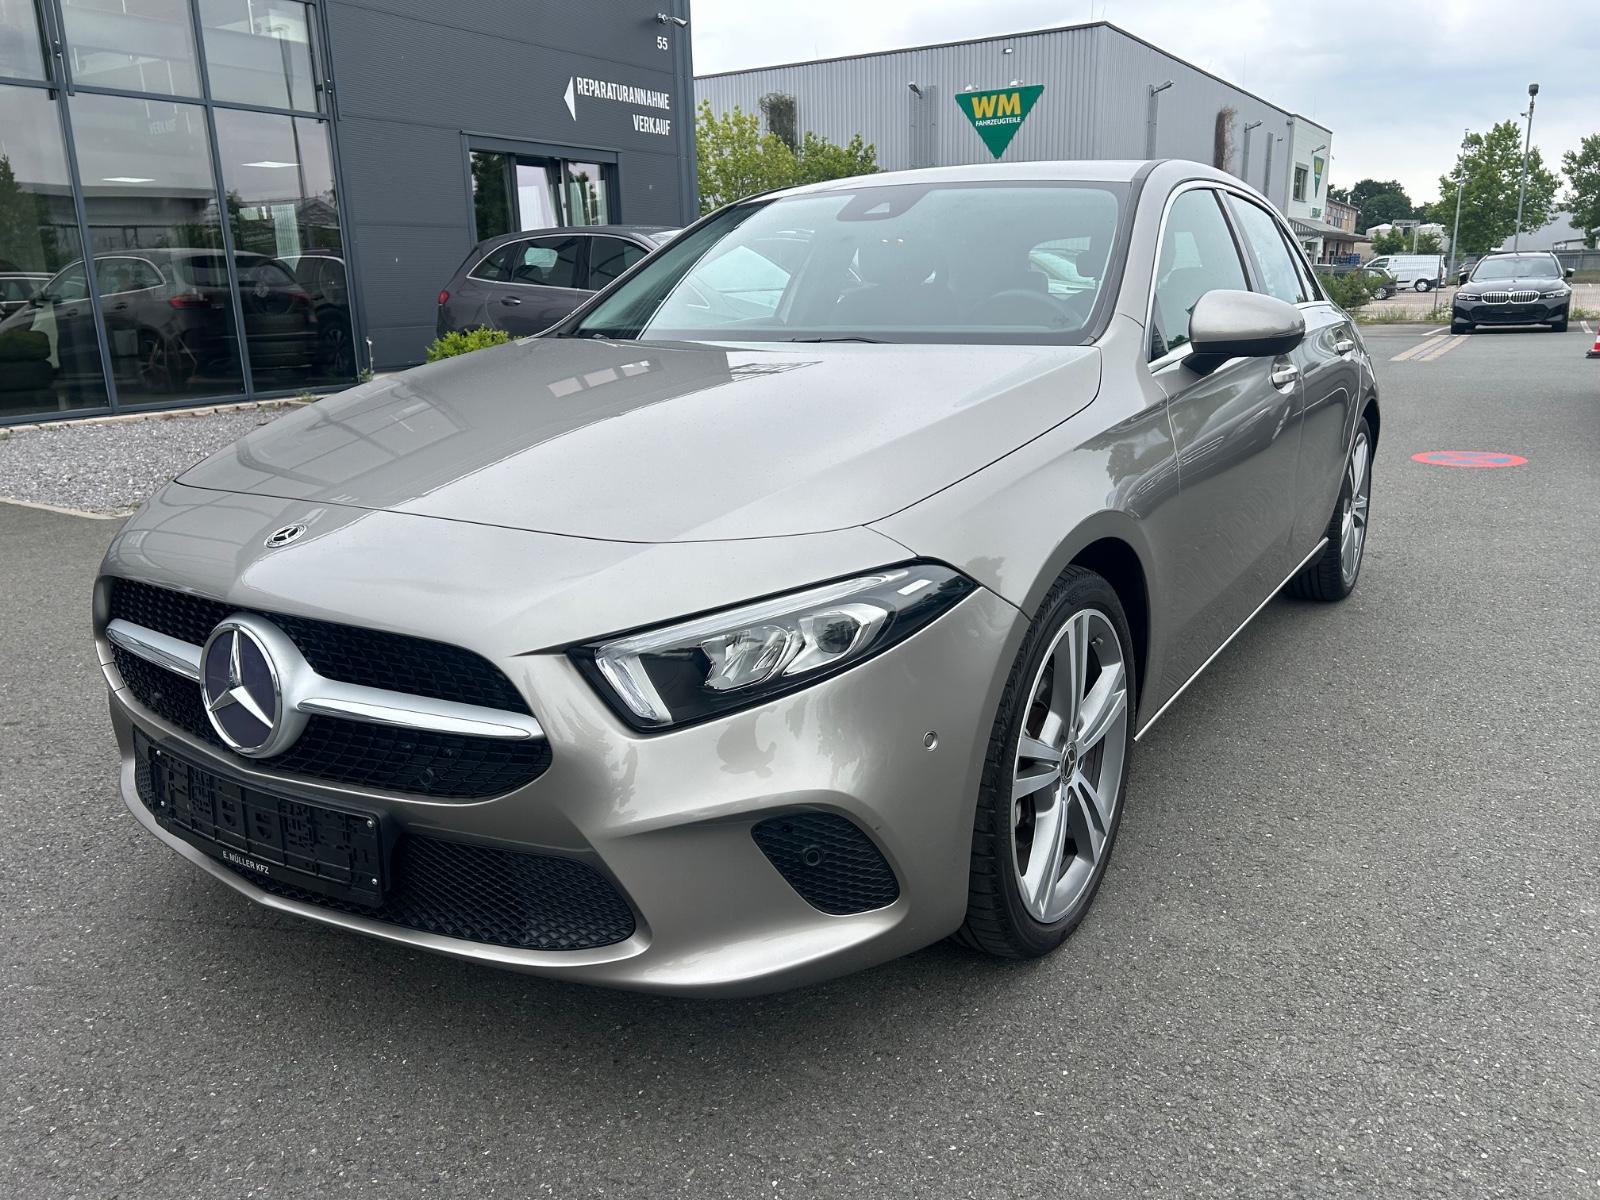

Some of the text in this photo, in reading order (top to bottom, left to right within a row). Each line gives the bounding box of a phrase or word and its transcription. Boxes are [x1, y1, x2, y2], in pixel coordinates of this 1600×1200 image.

[656, 36, 668, 50] 55
[576, 77, 670, 110] REPARATURANNAHME
[971, 92, 1022, 119] WM
[632, 114, 671, 136] VERKAUF
[975, 116, 1022, 127] FAHRZEUGTEILE
[229, 852, 255, 870] MÜLLER
[255, 862, 270, 875] KFZ
